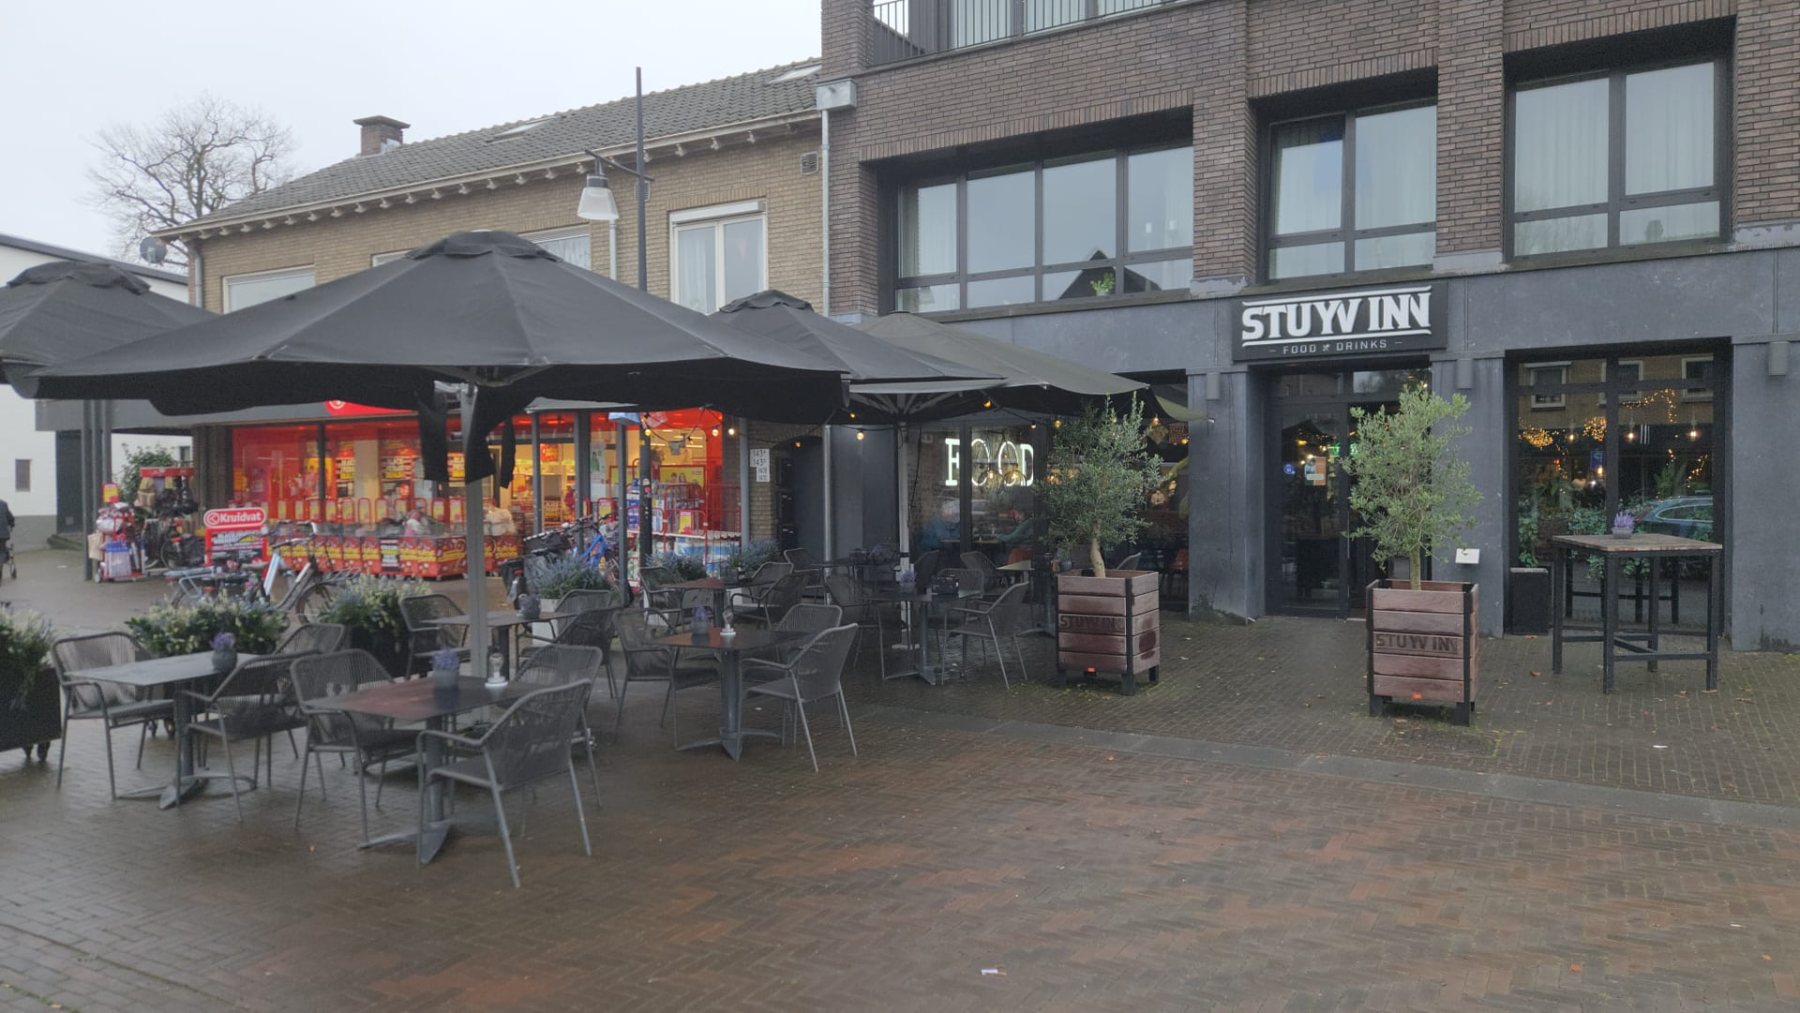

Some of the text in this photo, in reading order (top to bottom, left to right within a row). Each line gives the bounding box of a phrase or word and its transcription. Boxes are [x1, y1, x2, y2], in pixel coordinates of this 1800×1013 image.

[1242, 292, 1431, 340] STUYV INN
[1282, 339, 1388, 355] FOOD DRINKS
[945, 438, 1034, 486] FOOD
[220, 513, 261, 523] Kruidvat
